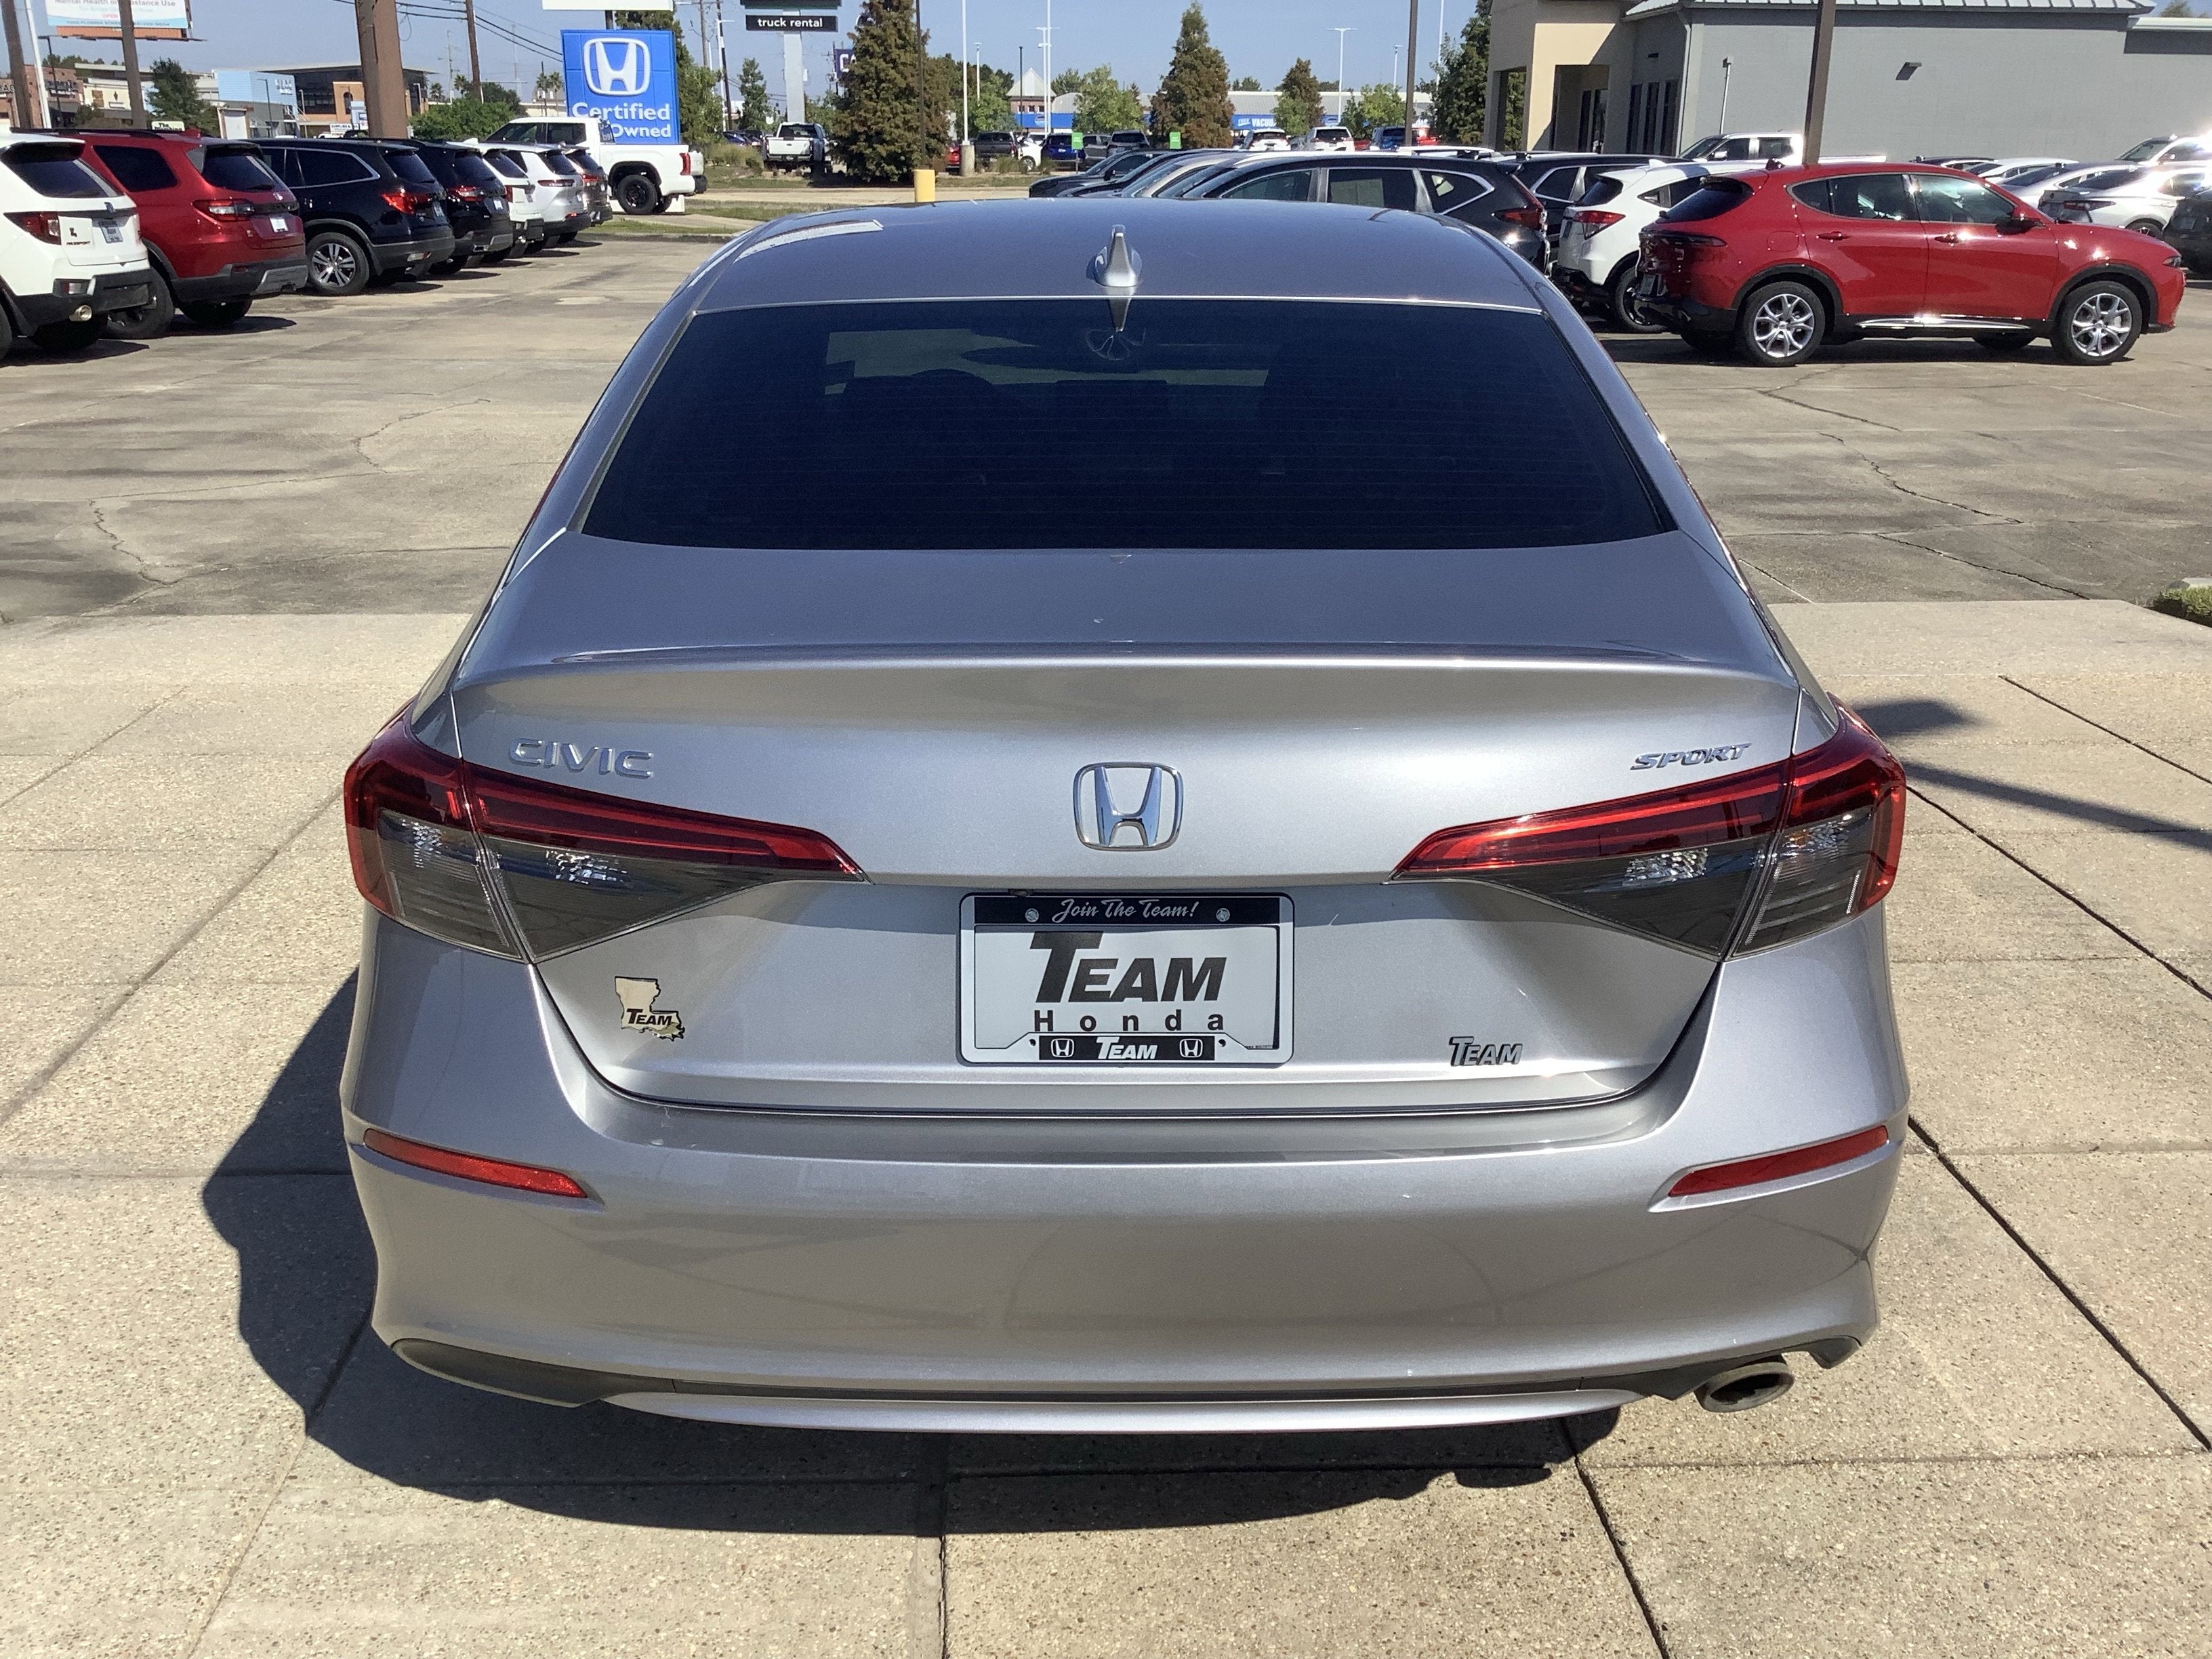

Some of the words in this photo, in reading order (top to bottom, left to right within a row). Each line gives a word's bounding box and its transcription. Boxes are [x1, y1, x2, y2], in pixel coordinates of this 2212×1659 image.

[758, 18, 787, 27] truck
[790, 18, 823, 27] rental
[572, 102, 670, 121] Certified
[611, 123, 672, 138] Owned
[510, 738, 653, 779] CIVIC
[1630, 743, 1753, 770] SPORT
[1052, 899, 1099, 923] Join
[1101, 899, 1136, 918] The
[1139, 899, 1200, 918] Team!
[1034, 1009, 1224, 1031] Honda
